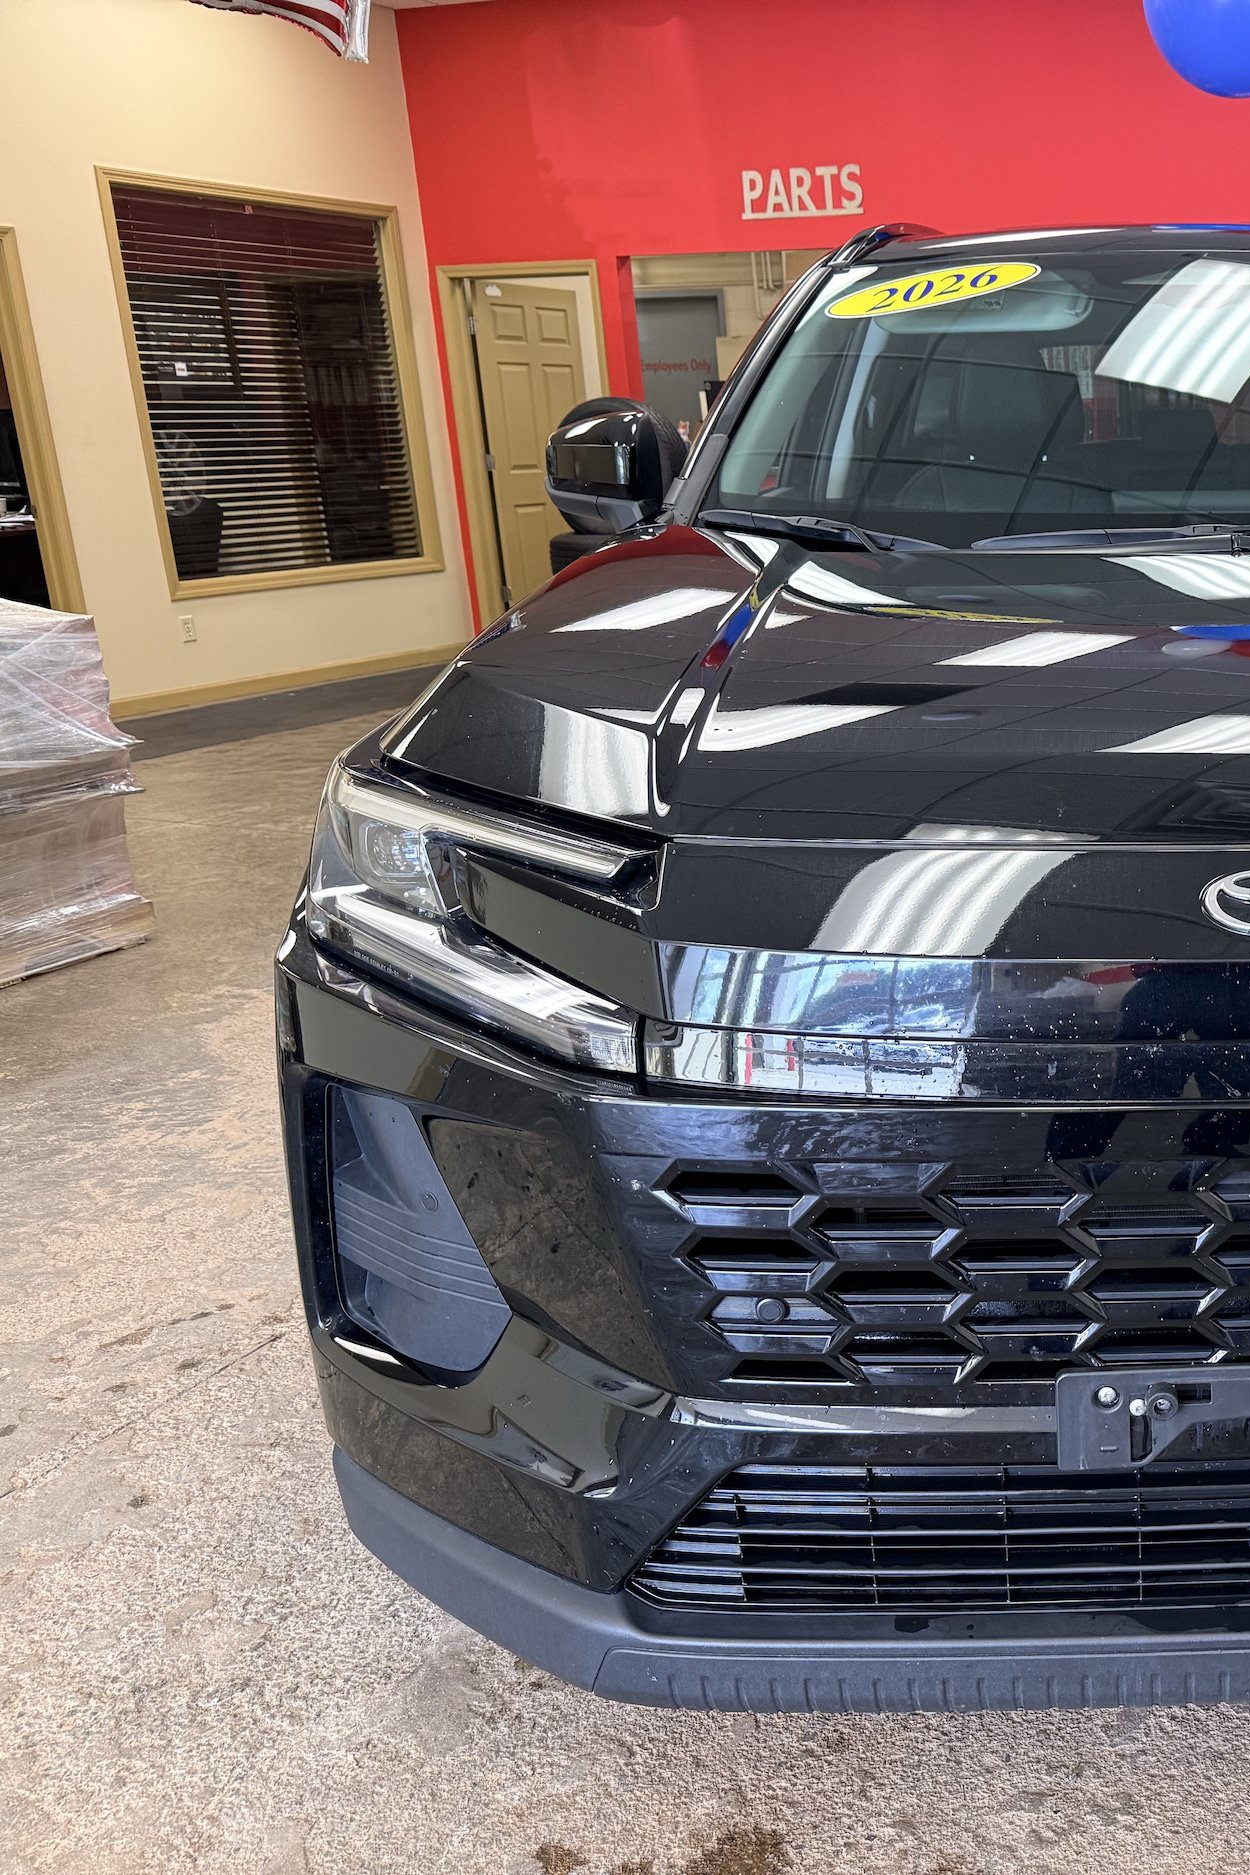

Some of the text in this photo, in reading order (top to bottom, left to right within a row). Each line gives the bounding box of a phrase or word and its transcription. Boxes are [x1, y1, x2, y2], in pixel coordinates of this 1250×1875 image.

[741, 163, 864, 214] PARTS
[866, 266, 1001, 312] 2026
[690, 359, 711, 375] Only
